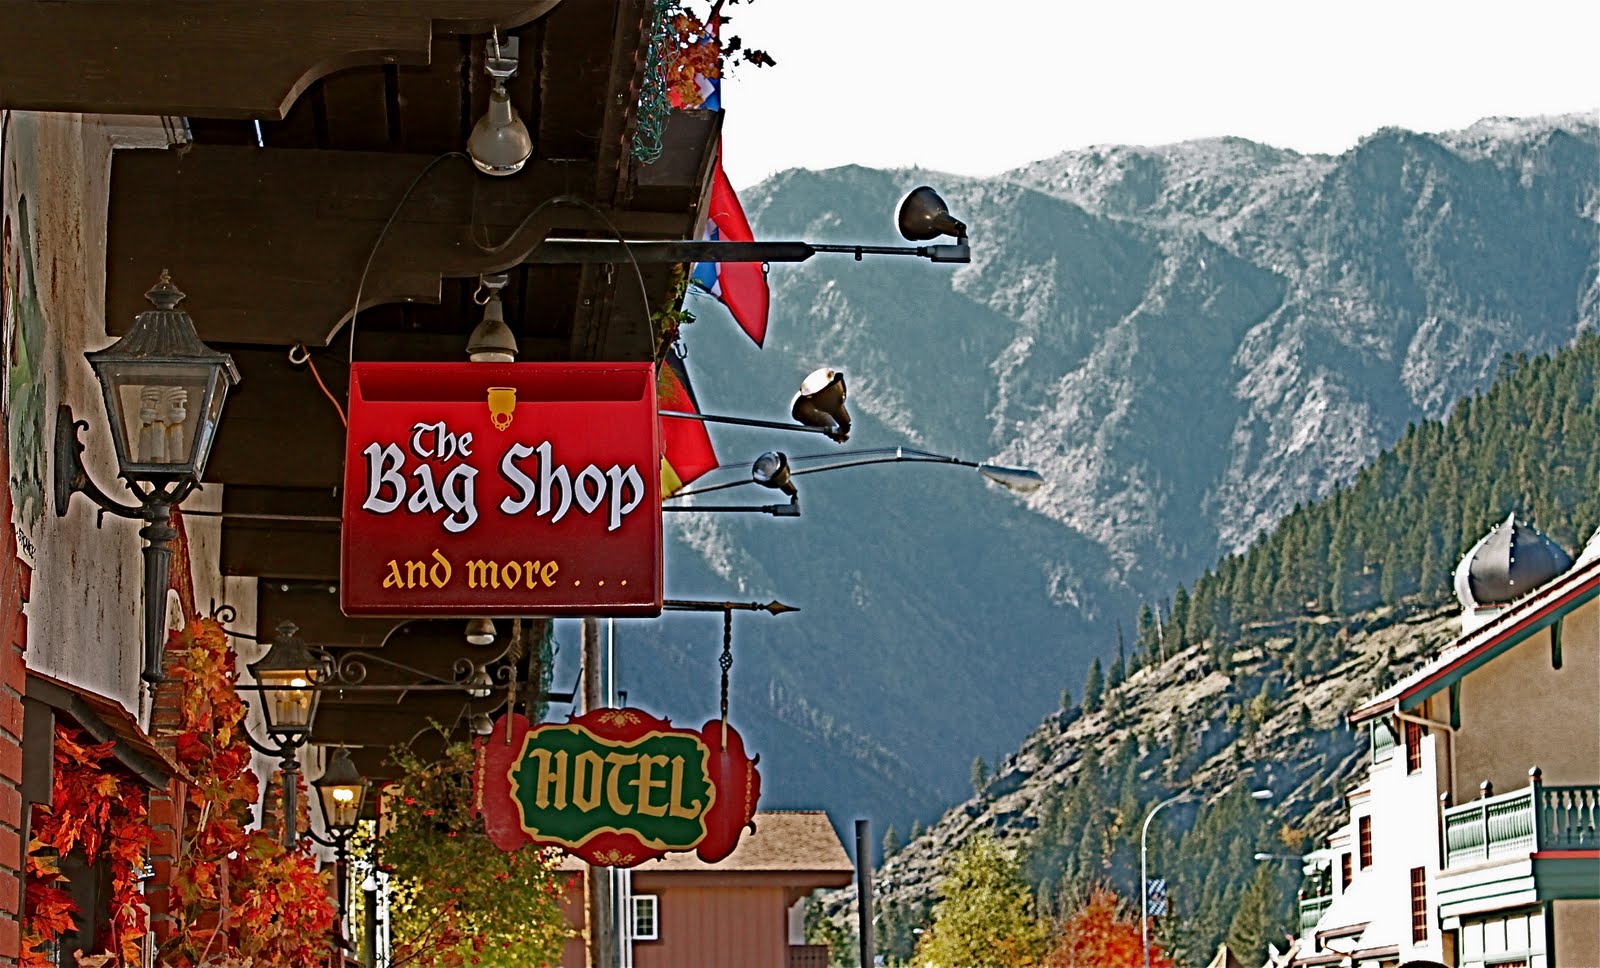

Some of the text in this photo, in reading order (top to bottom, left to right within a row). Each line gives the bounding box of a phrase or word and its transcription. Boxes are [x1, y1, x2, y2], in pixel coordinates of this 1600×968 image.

[412, 420, 474, 462] The
[362, 441, 645, 532] Bag Shop
[383, 549, 451, 589] and
[466, 559, 559, 589] more
[528, 748, 702, 820] HOTEL
